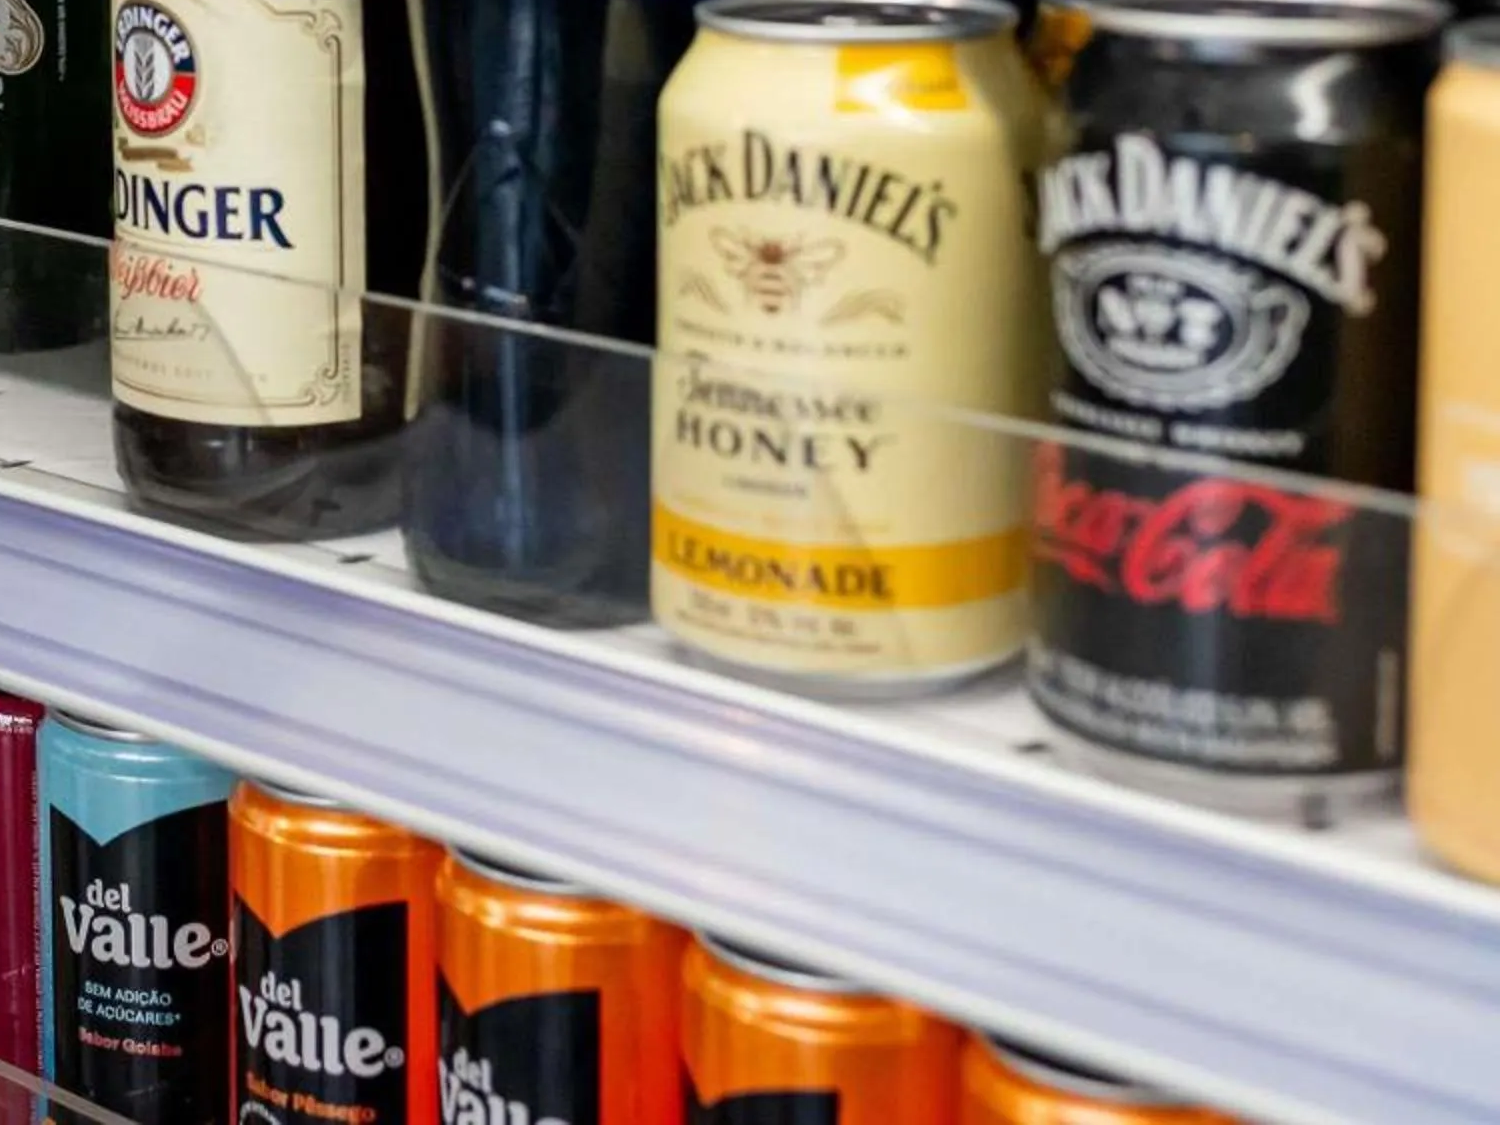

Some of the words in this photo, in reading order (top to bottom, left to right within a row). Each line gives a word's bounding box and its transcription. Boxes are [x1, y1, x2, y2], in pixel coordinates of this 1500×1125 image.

[743, 128, 958, 266] DANIEL'S
[1116, 131, 1389, 318] DANIEL'S
[676, 408, 897, 472] HONEY
[666, 530, 895, 602] LEMONADE
[86, 878, 132, 913] del
[60, 895, 212, 969] Valle
[77, 996, 93, 1014] DE
[85, 980, 112, 1000] SEM
[115, 988, 173, 1007] ADIÇÃO
[260, 970, 303, 1012] del
[239, 984, 386, 1078] Valle
[438, 1055, 572, 1125] Vall
[453, 1046, 493, 1095] del
